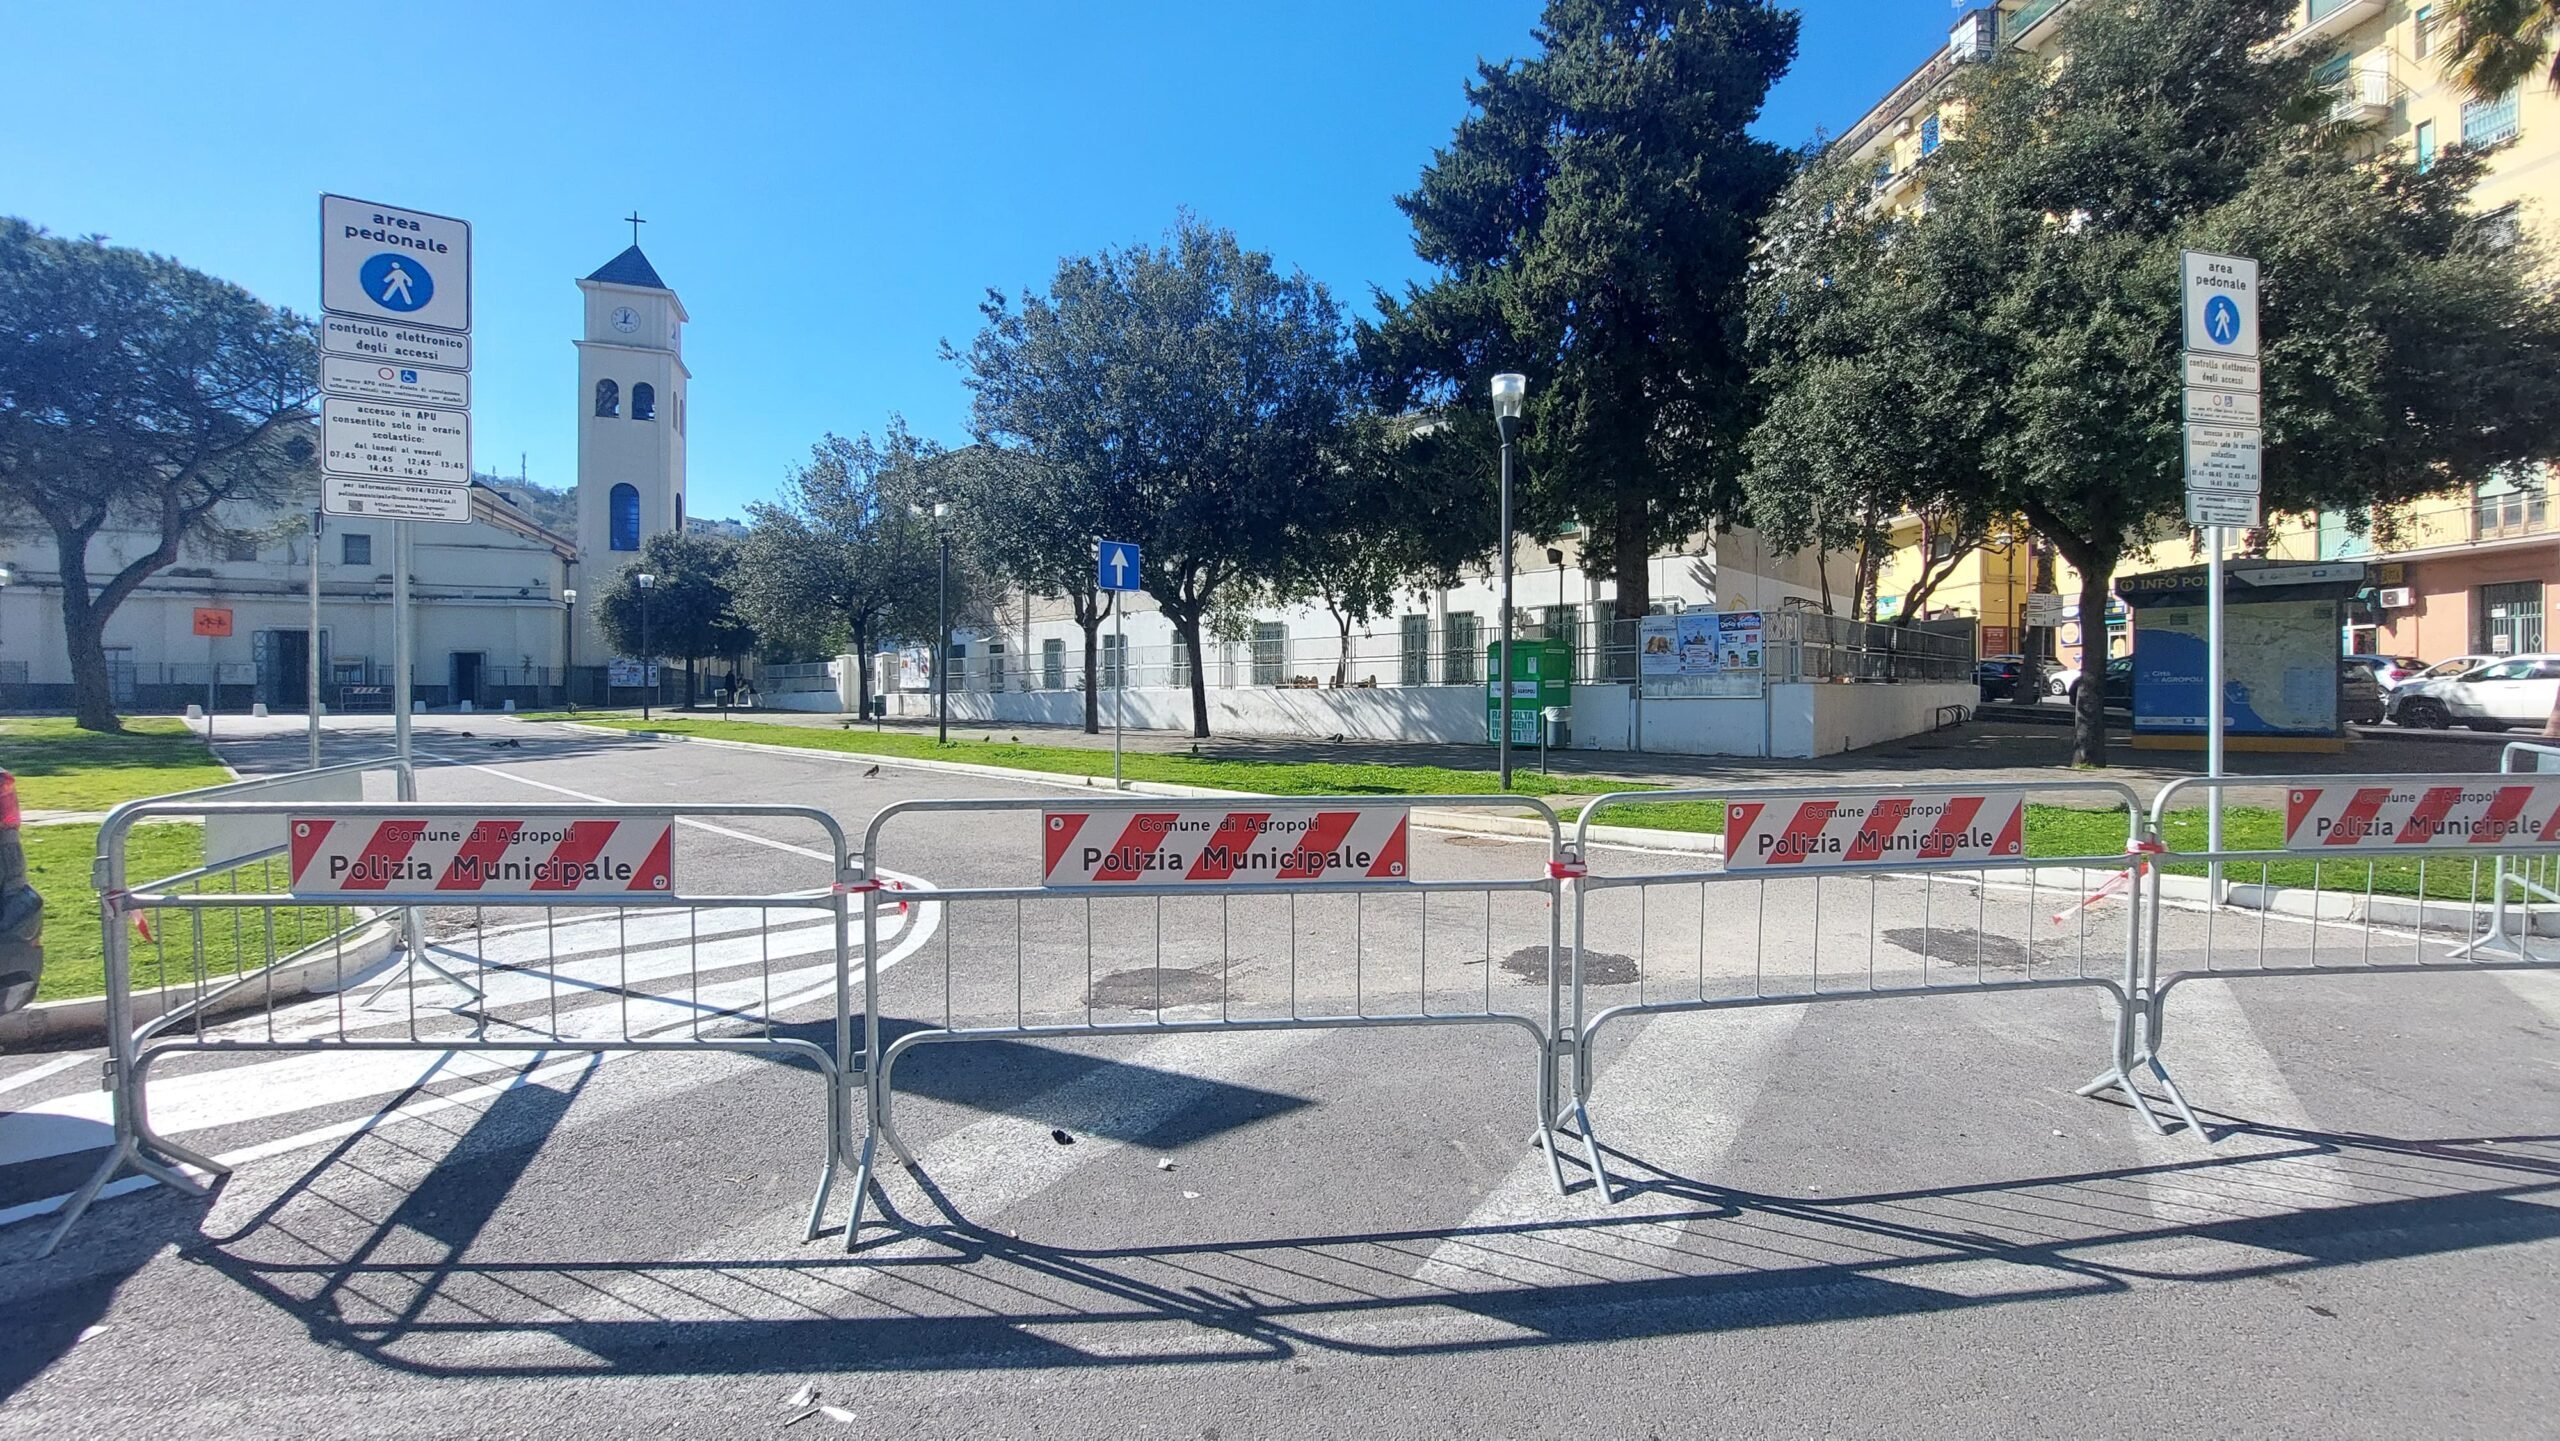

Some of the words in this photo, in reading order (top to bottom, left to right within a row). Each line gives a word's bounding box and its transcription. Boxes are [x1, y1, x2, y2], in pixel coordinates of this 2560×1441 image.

[373, 213, 421, 232] area
[345, 225, 448, 254] pedonale
[2209, 263, 2232, 274] area
[2196, 275, 2246, 290] pedonale
[329, 322, 388, 338] controllo
[396, 331, 463, 349] elettronico
[356, 340, 388, 354] degli
[395, 347, 439, 360] accessi
[2202, 372, 2218, 383] degli
[358, 406, 395, 417] accesso
[402, 409, 411, 418] in
[417, 411, 437, 421] APU
[332, 415, 386, 427] consentito
[392, 421, 412, 430] solo
[418, 423, 426, 432] in
[432, 426, 461, 435] orario
[329, 450, 356, 460] 07:45
[366, 454, 393, 463] 08:45
[407, 457, 431, 466] 12:45
[441, 461, 464, 470] 13:45
[369, 464, 394, 473] 14:45
[404, 467, 428, 476] 16:45
[2141, 577, 2177, 590] INFO
[2182, 575, 2232, 587] POIT
[1805, 804, 1864, 820] Comune
[1871, 803, 1885, 817] di
[1891, 801, 1952, 819] Agropoli
[1138, 817, 1210, 832] Comune
[1219, 816, 1236, 832] di
[1245, 816, 1319, 834] Agropoli
[2316, 815, 2393, 838] Polizia
[2408, 814, 2541, 839] Municipale
[386, 827, 461, 842] Comune
[470, 826, 487, 842] di
[496, 826, 576, 845] Agropoli
[1758, 832, 1841, 856] Polizia
[1856, 826, 1993, 853] Municipale
[1083, 846, 1183, 871] Polizia
[1202, 845, 1370, 875] Municipale
[330, 855, 433, 881] Polizia
[453, 853, 632, 887] Municipale
